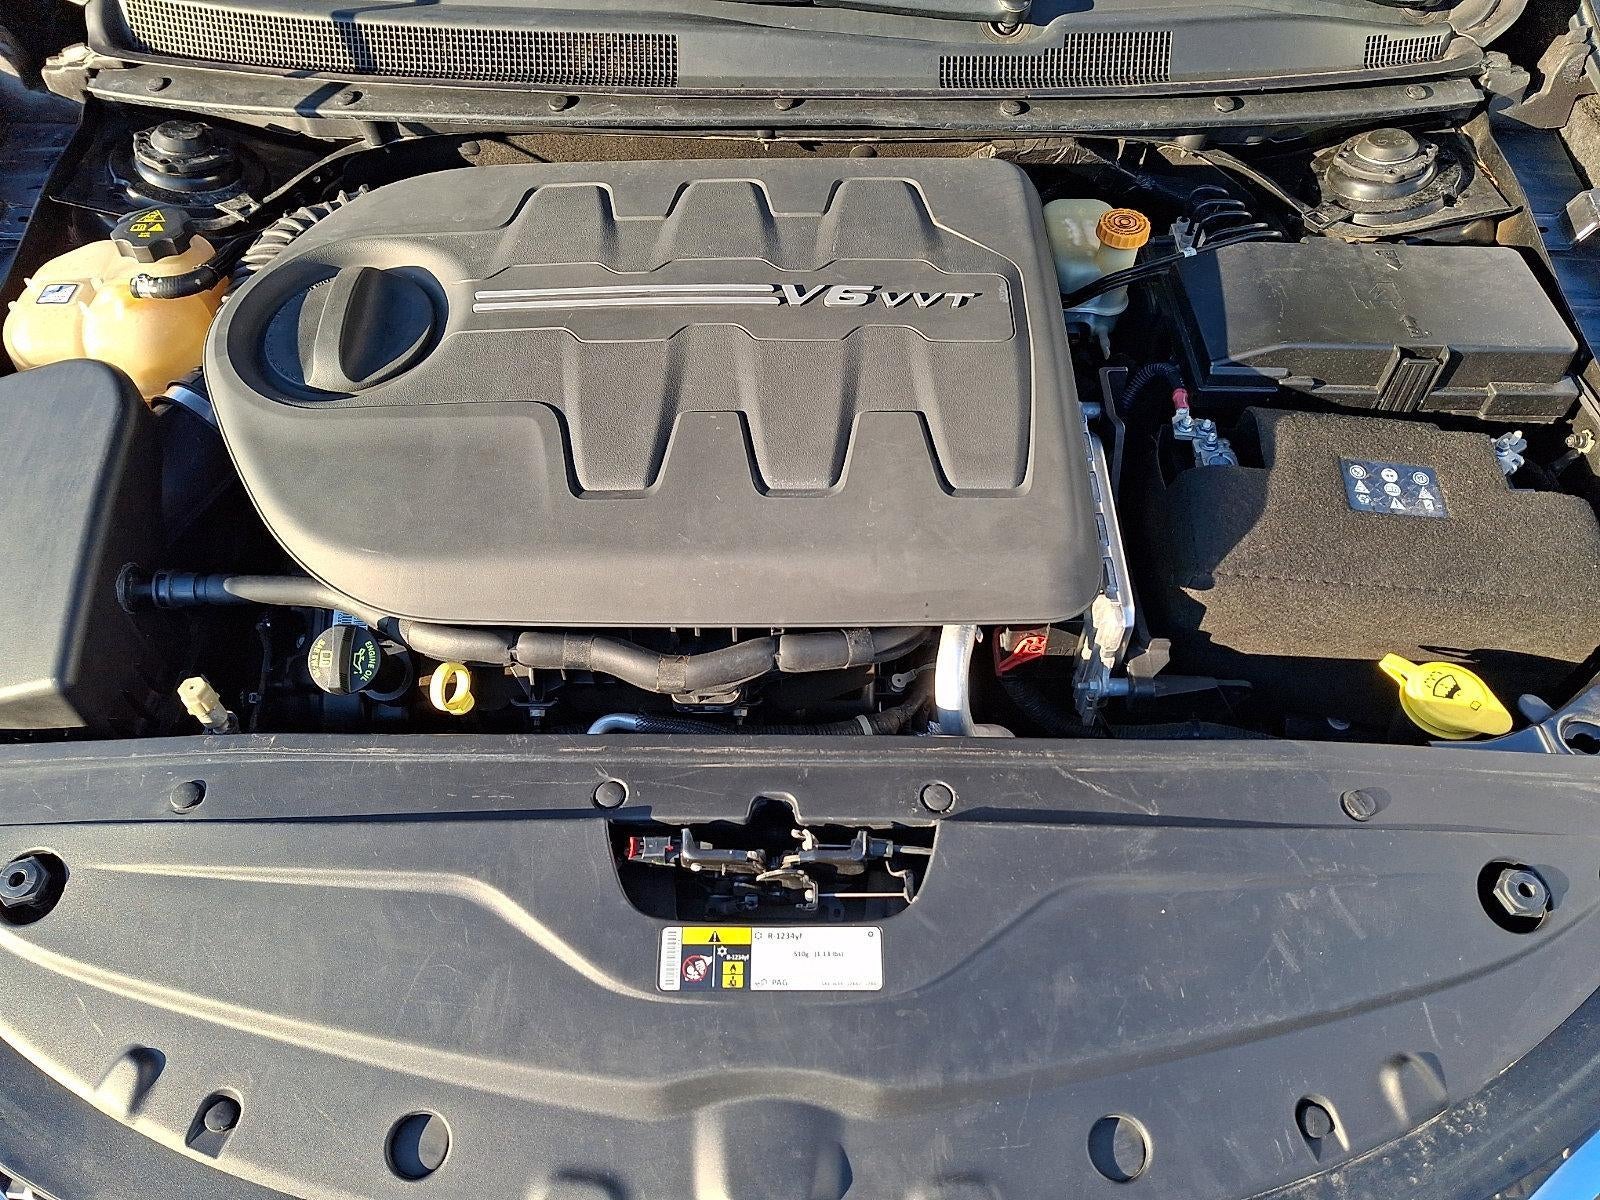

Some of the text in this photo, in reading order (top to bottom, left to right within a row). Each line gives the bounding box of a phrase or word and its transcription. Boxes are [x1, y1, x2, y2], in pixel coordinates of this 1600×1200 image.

[781, 284, 981, 309] V6 VVT
[360, 640, 377, 682] ENGINE OIL
[767, 932, 803, 941] R-1234yf
